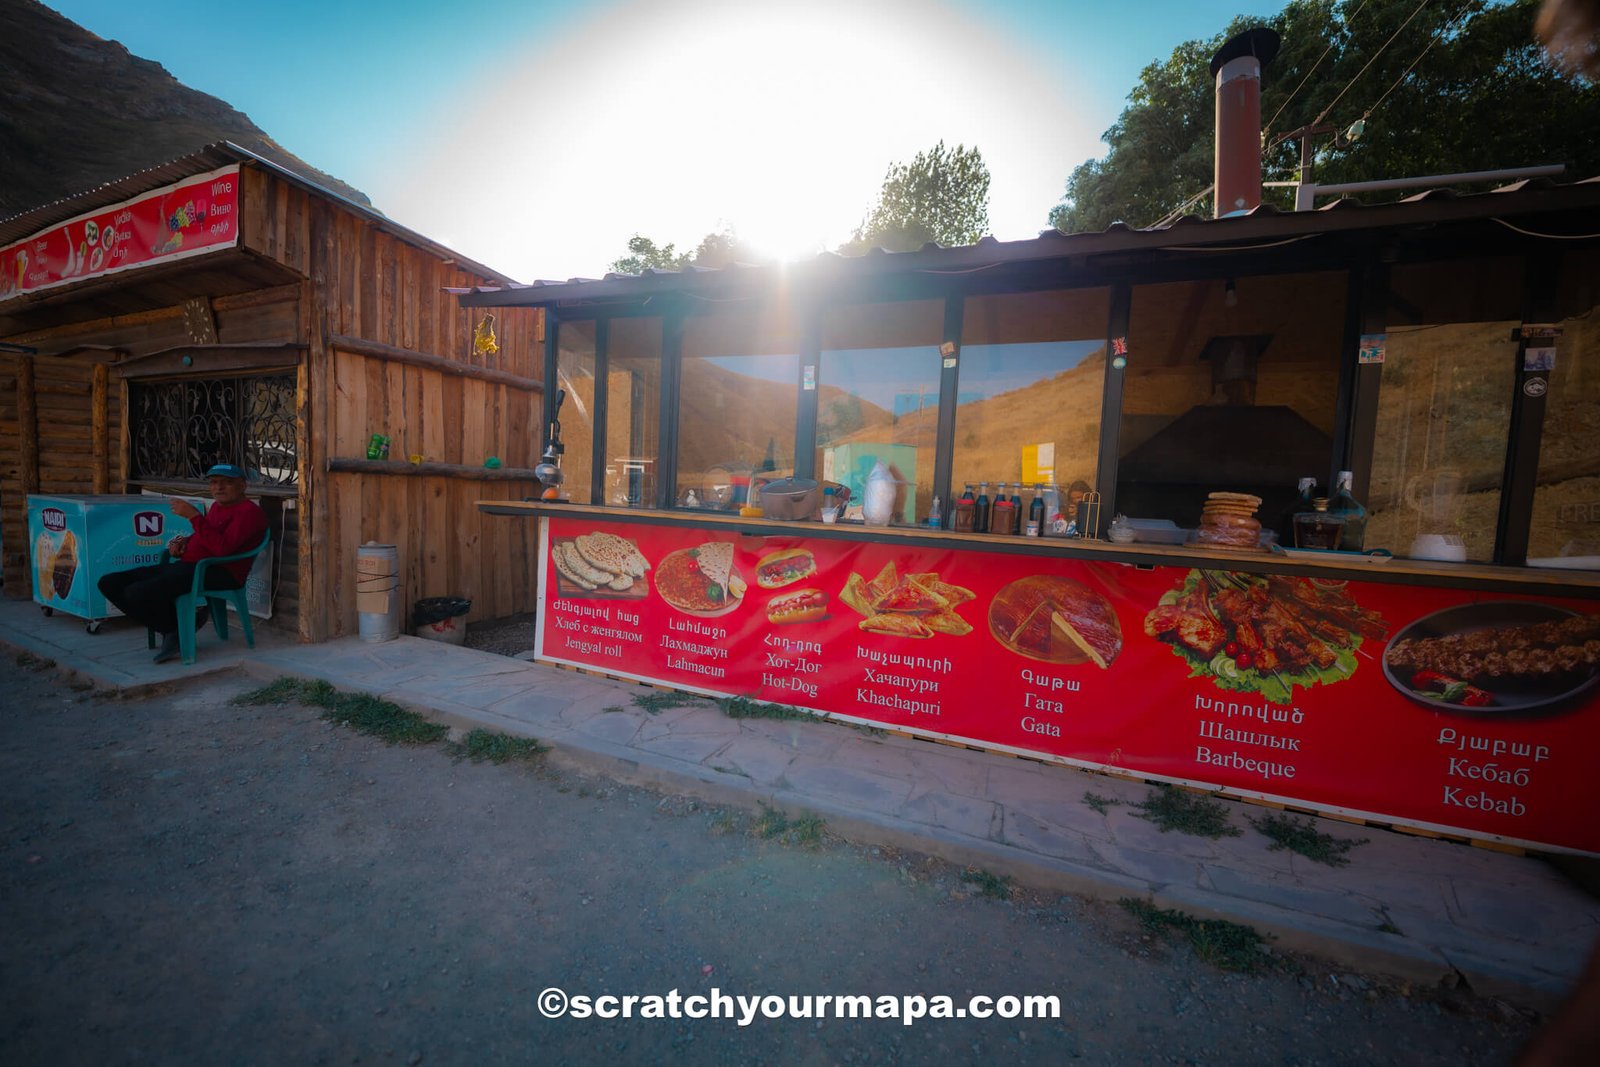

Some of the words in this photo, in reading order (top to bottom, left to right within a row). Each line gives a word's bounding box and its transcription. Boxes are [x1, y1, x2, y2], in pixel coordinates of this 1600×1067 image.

[211, 182, 232, 197] Wine
[210, 203, 232, 217] Вино
[140, 516, 158, 533] N
[553, 599, 610, 621] Ժենգյալով
[617, 609, 639, 626] հաց
[555, 615, 581, 631] Хлеб
[582, 624, 589, 633] с
[590, 625, 643, 643] женгялом
[565, 635, 602, 655] Jengyal
[604, 644, 622, 657] roll
[660, 634, 728, 660] Лахмаджун
[856, 645, 953, 673] Խաչապուրի
[666, 654, 726, 679] Lahmacun
[765, 652, 823, 675] Хот-Дог
[762, 672, 819, 698] Hot-Dog
[863, 667, 940, 693] Хачапури
[1020, 669, 1081, 692] Գաթա
[856, 687, 942, 716] Khachapuri
[1024, 692, 1064, 714] Гата
[1195, 694, 1305, 725] Խորոված
[1020, 716, 1062, 738] Gata
[1199, 720, 1301, 752] Шашлык
[1437, 727, 1551, 762] Քյաբաբ
[1195, 745, 1297, 779] Barbeque
[1447, 756, 1531, 788] Кебаб
[1442, 785, 1527, 818] Kebab
